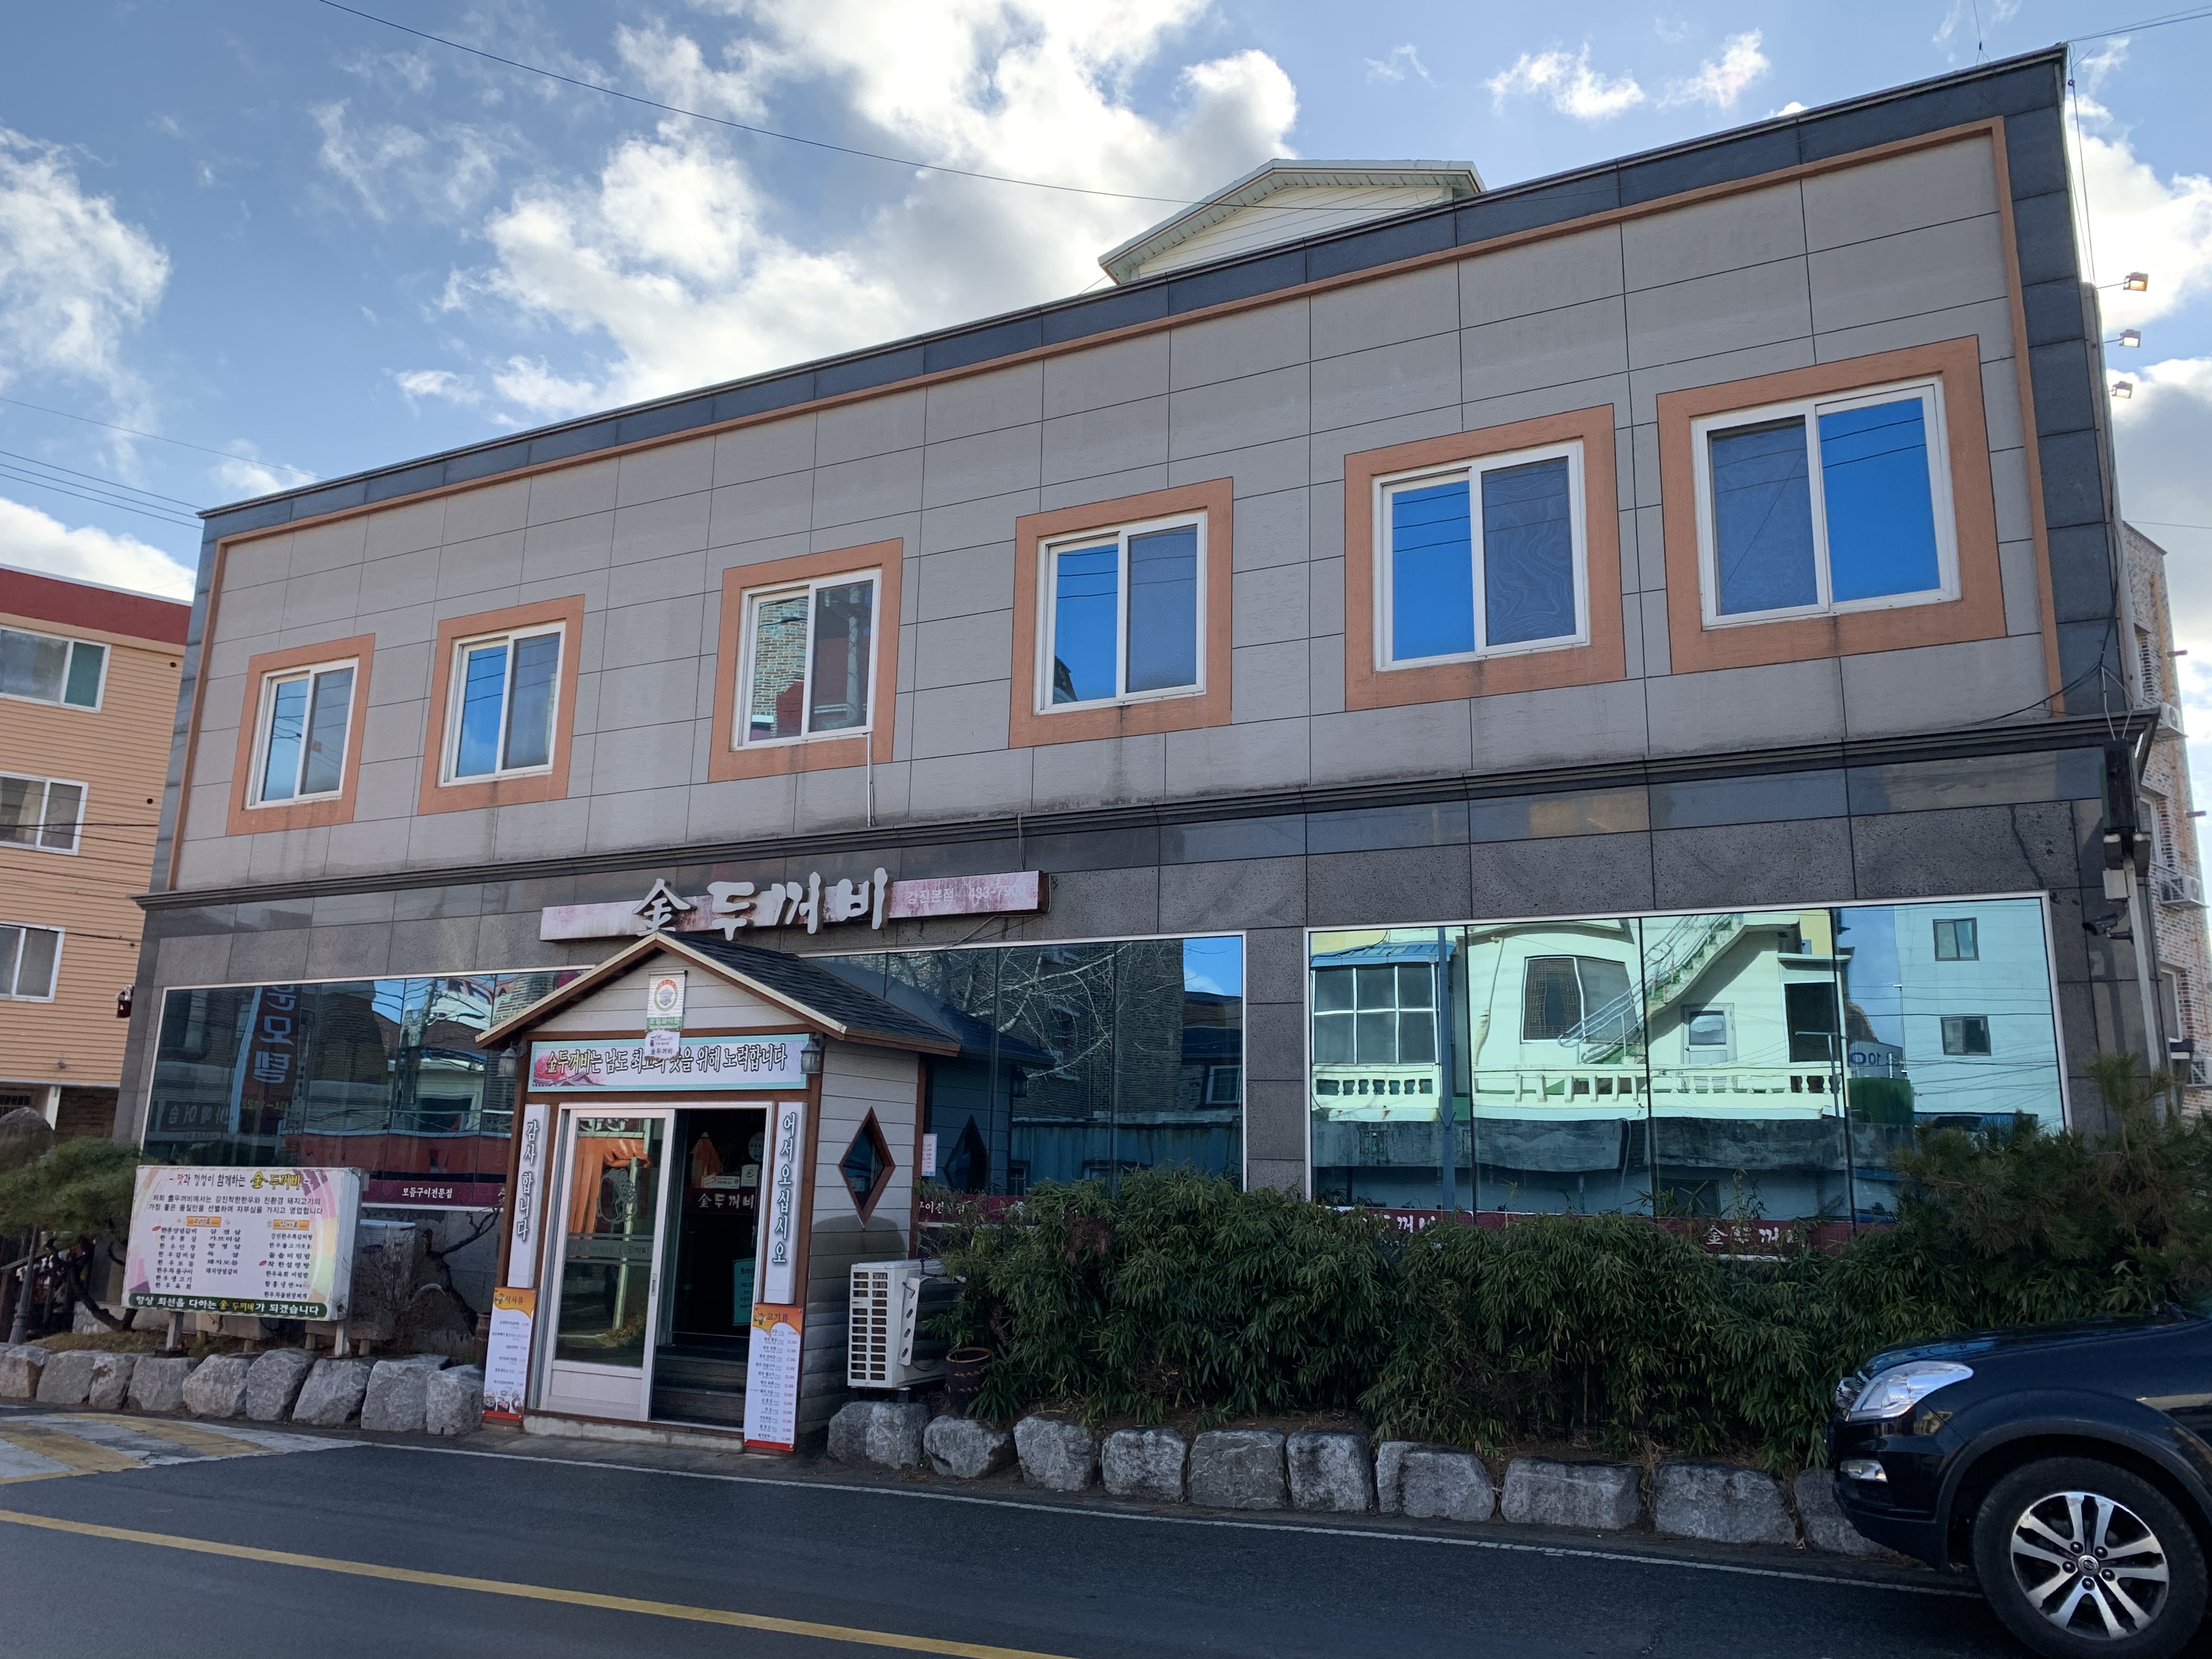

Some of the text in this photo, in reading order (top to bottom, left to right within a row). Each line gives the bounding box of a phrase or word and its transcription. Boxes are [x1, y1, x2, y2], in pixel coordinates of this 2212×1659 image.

[907, 884, 1028, 905] 강진본점 433-7900
[546, 1048, 603, 1075] 金두꺼비는
[605, 1048, 629, 1074] 남도
[696, 1045, 722, 1073] 위해
[723, 1043, 788, 1072] 노력합니다
[177, 1171, 302, 1190] 맛과 정성이 함께하는 金두꺼비
[167, 1195, 212, 1203] 金두꺼비에서는
[215, 1196, 261, 1204] 강진착한한우와
[402, 1187, 453, 1199] 모듬구이전문점
[179, 1204, 204, 1212] 품질만을
[697, 1193, 755, 1210] 金두꺼비
[136, 1295, 154, 1306] 항상
[157, 1296, 185, 1307] 최선을
[189, 1299, 217, 1310] 다하는
[269, 1304, 319, 1315] 되겠습니다
[505, 1295, 524, 1306] 식사류
[766, 1313, 789, 1324] 고기류
